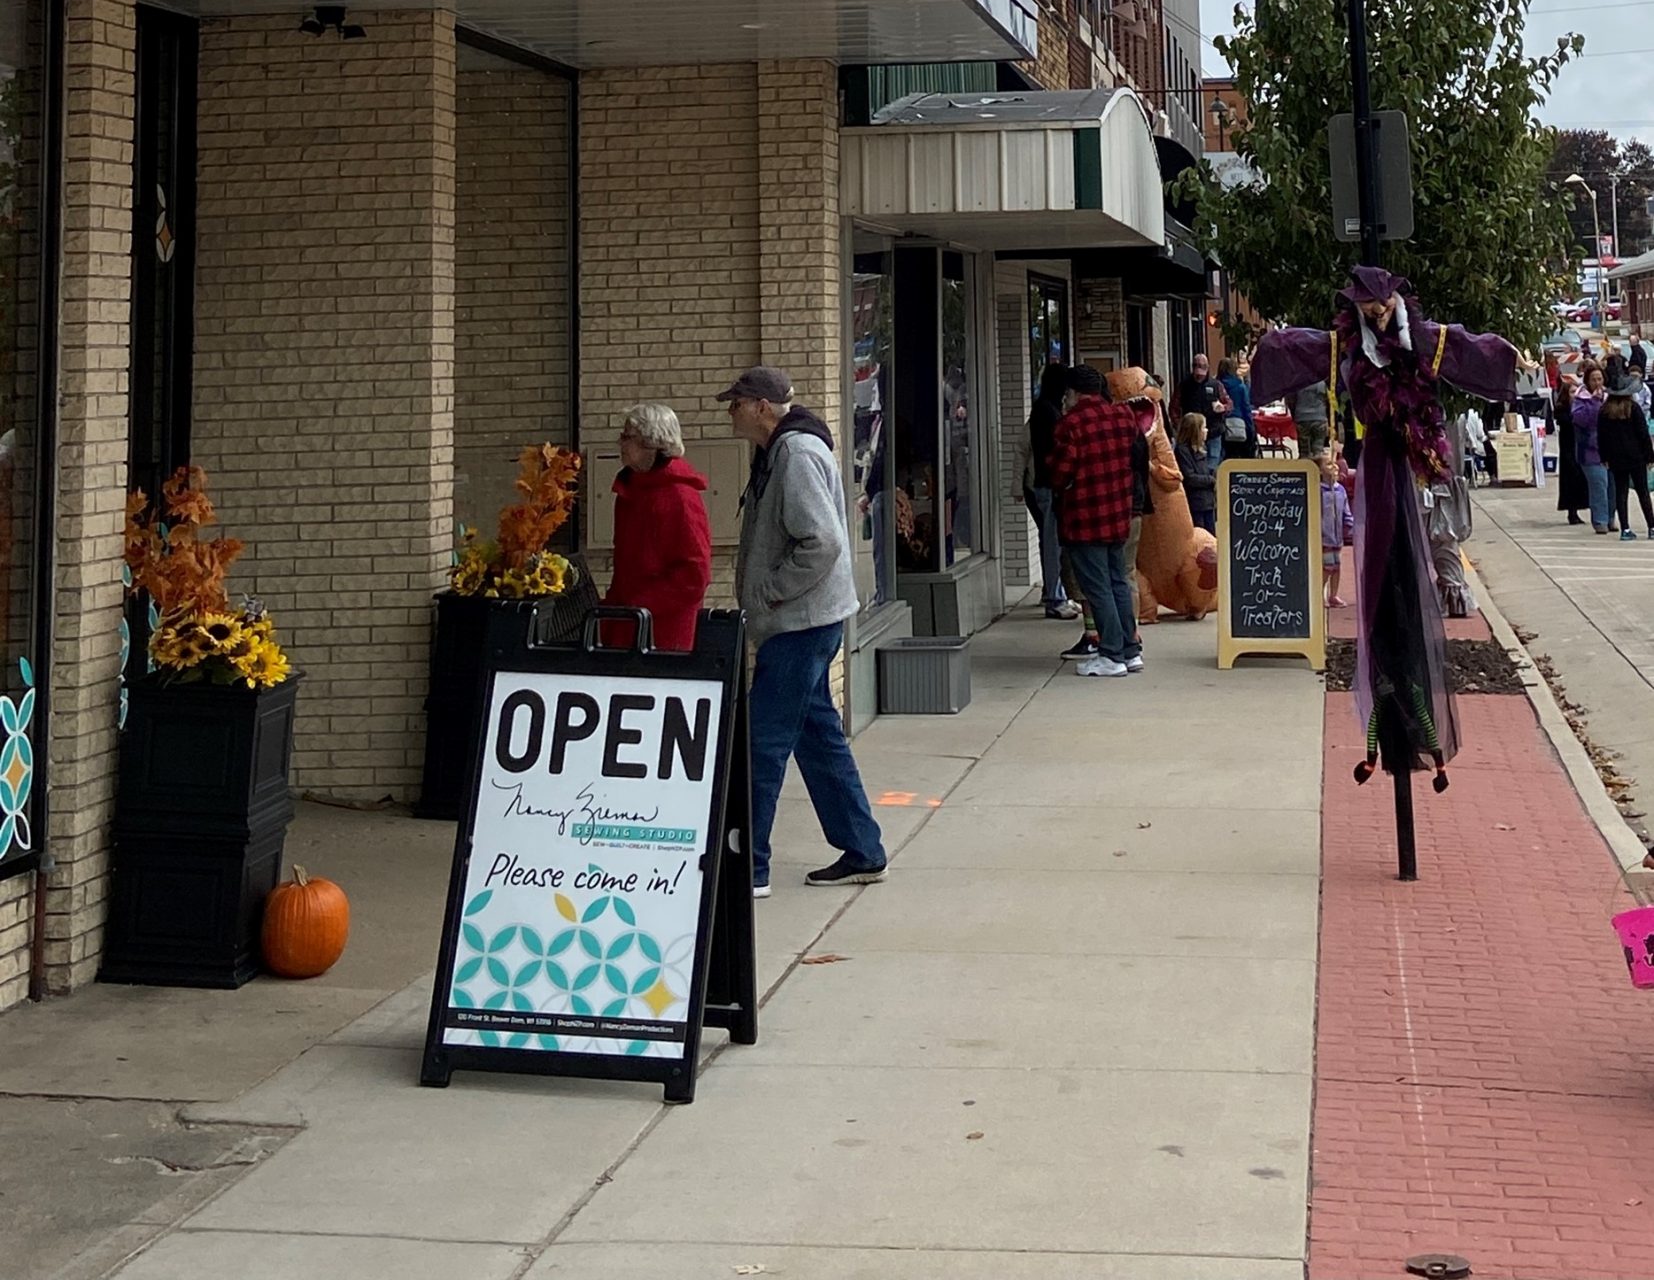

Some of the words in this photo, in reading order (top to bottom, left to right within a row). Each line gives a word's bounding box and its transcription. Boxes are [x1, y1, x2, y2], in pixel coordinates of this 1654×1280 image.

[1232, 497, 1266, 522] Open
[1266, 499, 1304, 526] Today
[1248, 519, 1285, 538] 10-4
[1233, 536, 1300, 566] Welcome
[1244, 564, 1286, 588] Trick
[1240, 604, 1303, 630] Treaters
[495, 688, 711, 782] OPEN
[491, 777, 574, 836] Nancy
[575, 781, 659, 846] Zieman
[576, 825, 631, 838] SEWING
[639, 829, 694, 840] STUDIO
[484, 852, 565, 887] Please
[573, 871, 639, 892] come
[646, 860, 687, 895] in!
